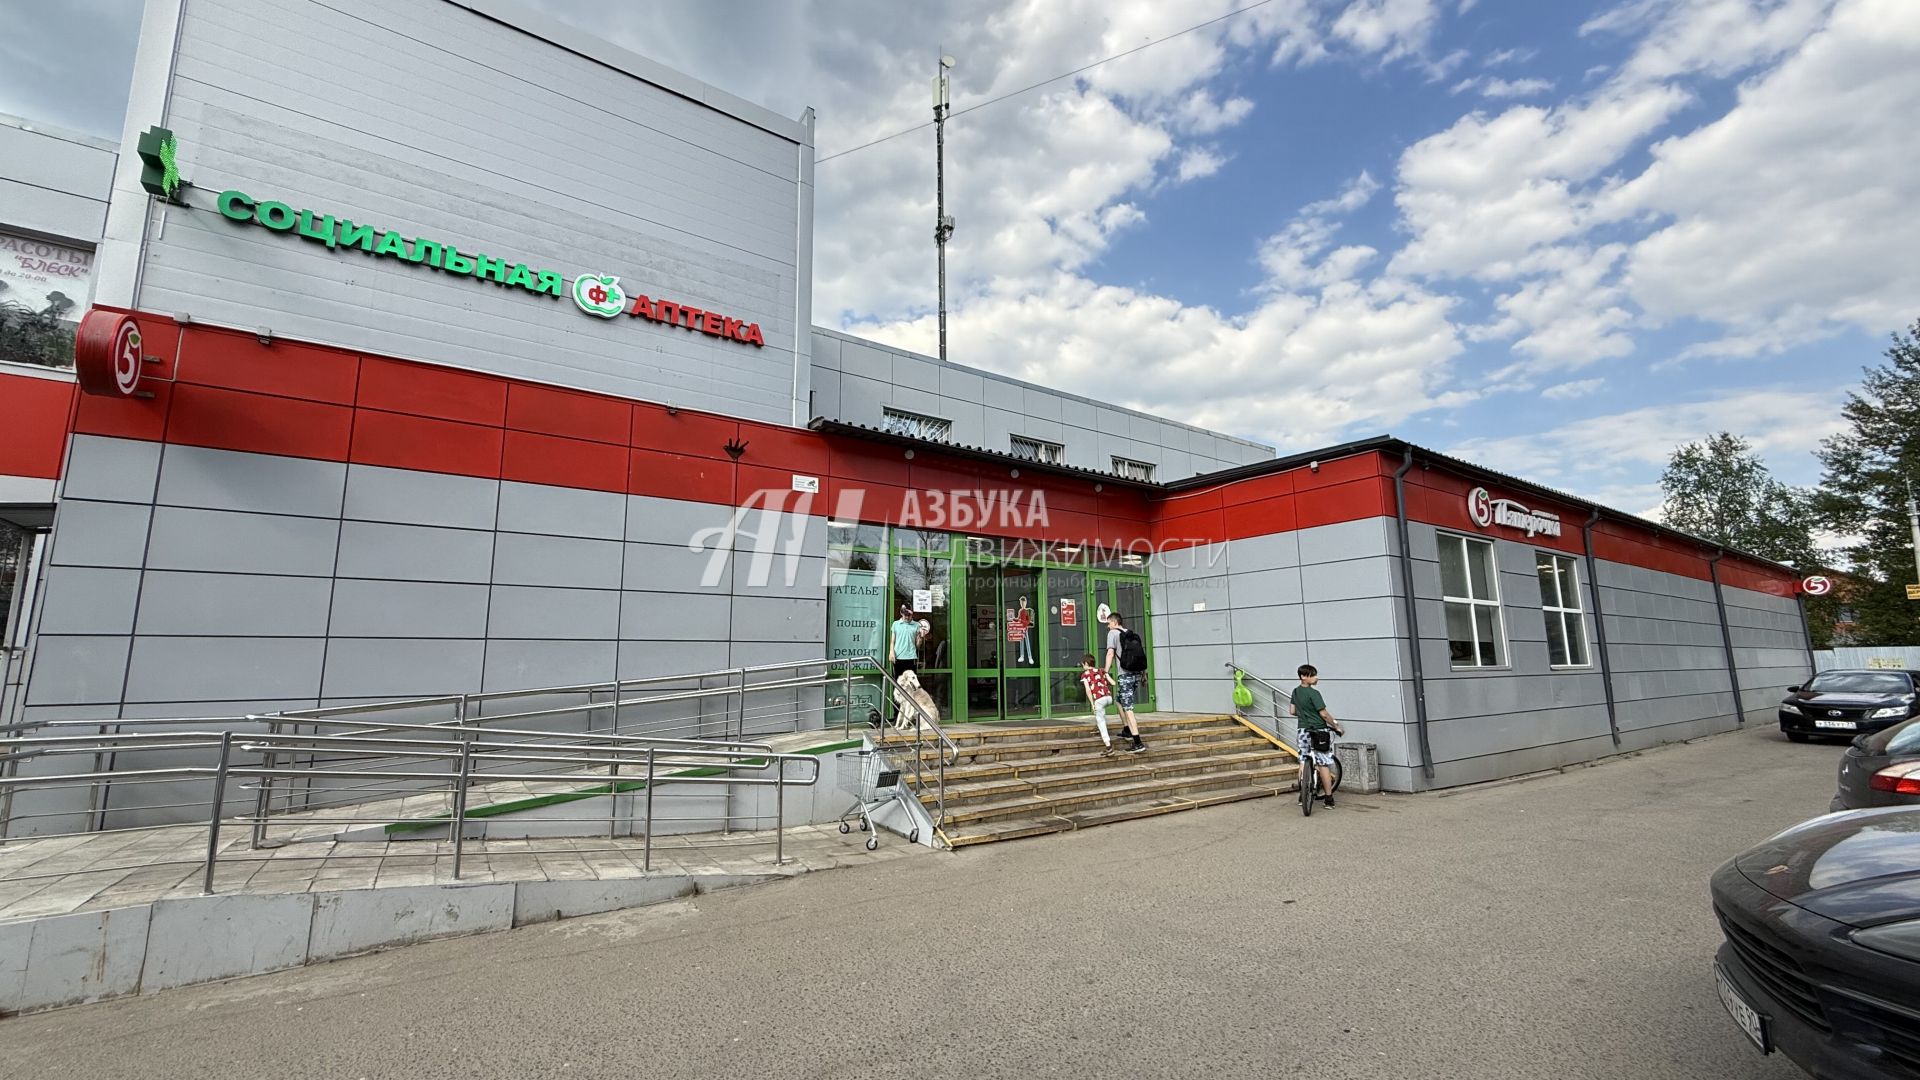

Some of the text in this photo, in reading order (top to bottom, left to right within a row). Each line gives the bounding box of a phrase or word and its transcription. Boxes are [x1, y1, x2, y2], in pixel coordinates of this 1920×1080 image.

[217, 189, 563, 301] СОЦИАЛЬНАЯ
[630, 294, 766, 347] АПТЕКА
[834, 585, 880, 596] АТЕЛЬЕ
